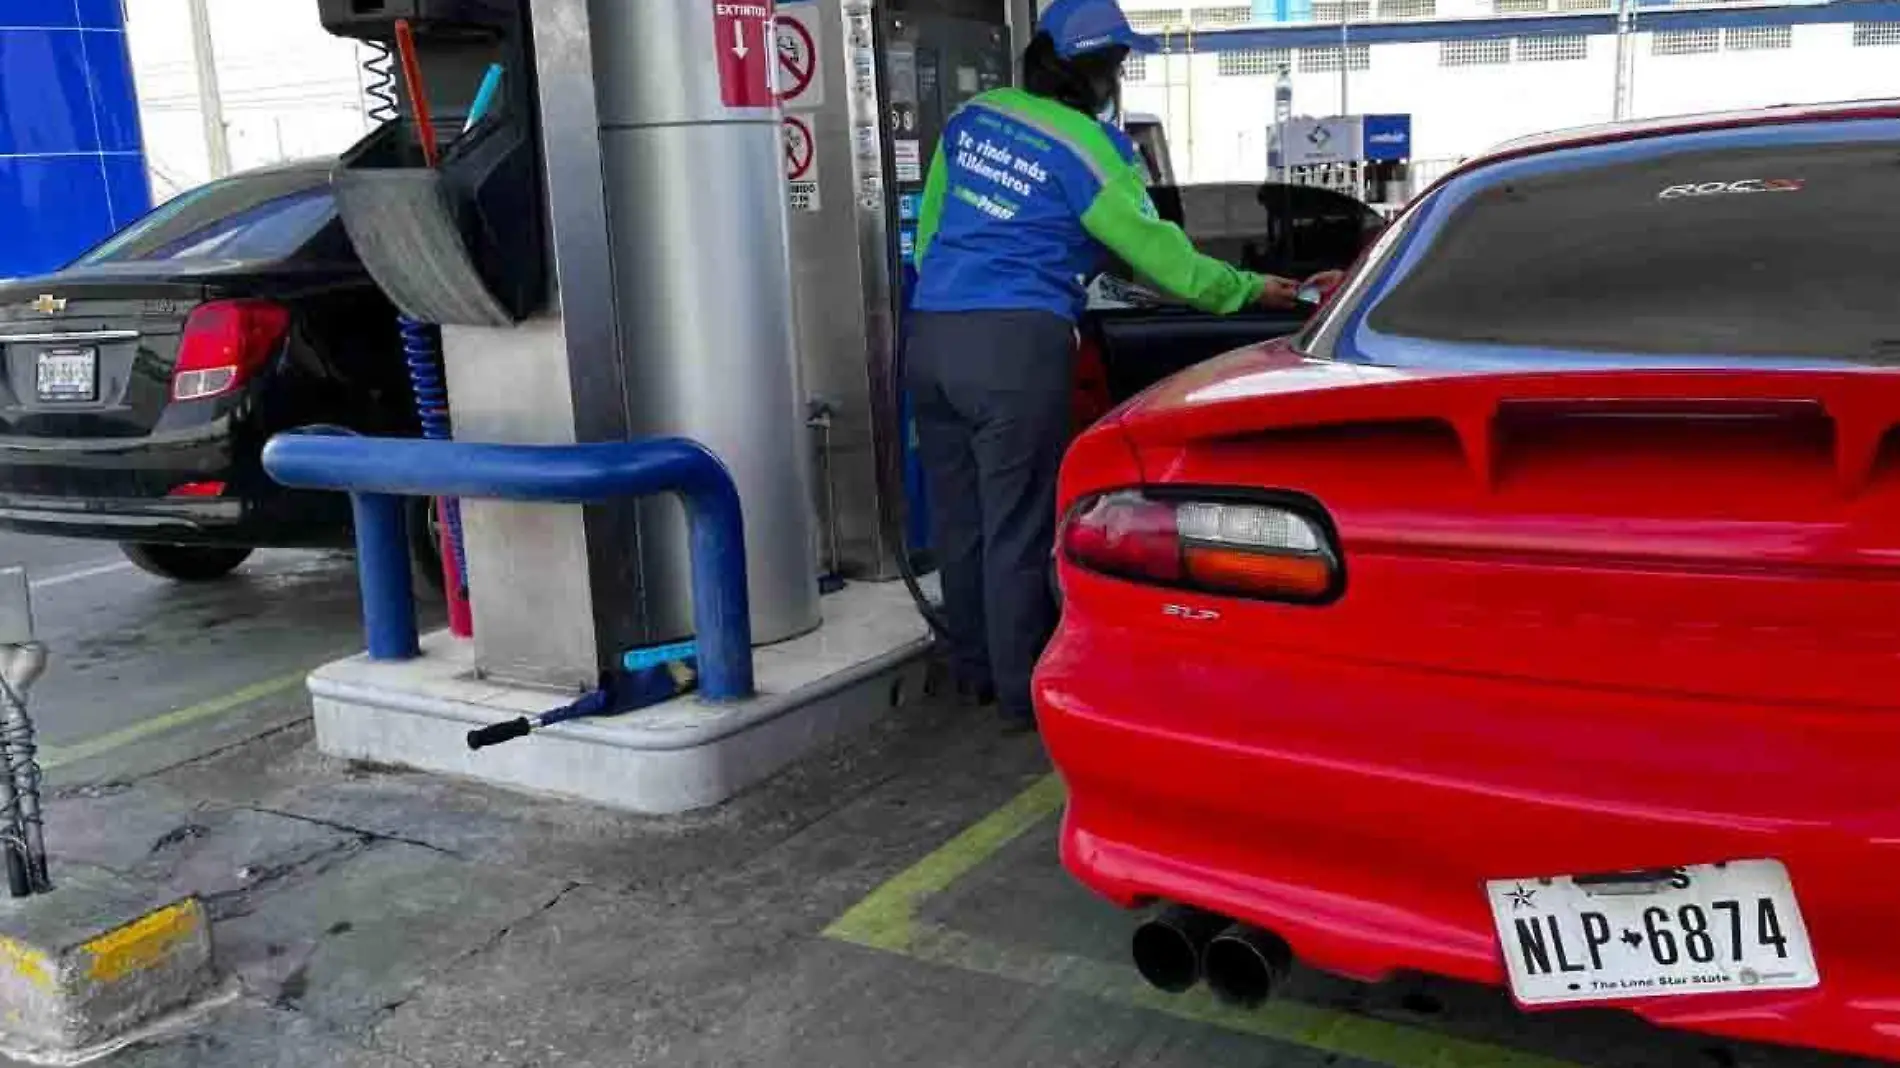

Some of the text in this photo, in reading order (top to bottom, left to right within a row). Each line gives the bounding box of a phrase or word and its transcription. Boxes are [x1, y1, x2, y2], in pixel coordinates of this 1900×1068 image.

[958, 130, 974, 149] Te
[976, 139, 1013, 165] rinde
[1514, 897, 1788, 975] NLP 6874
[1592, 973, 1731, 990] The Lone Star State
